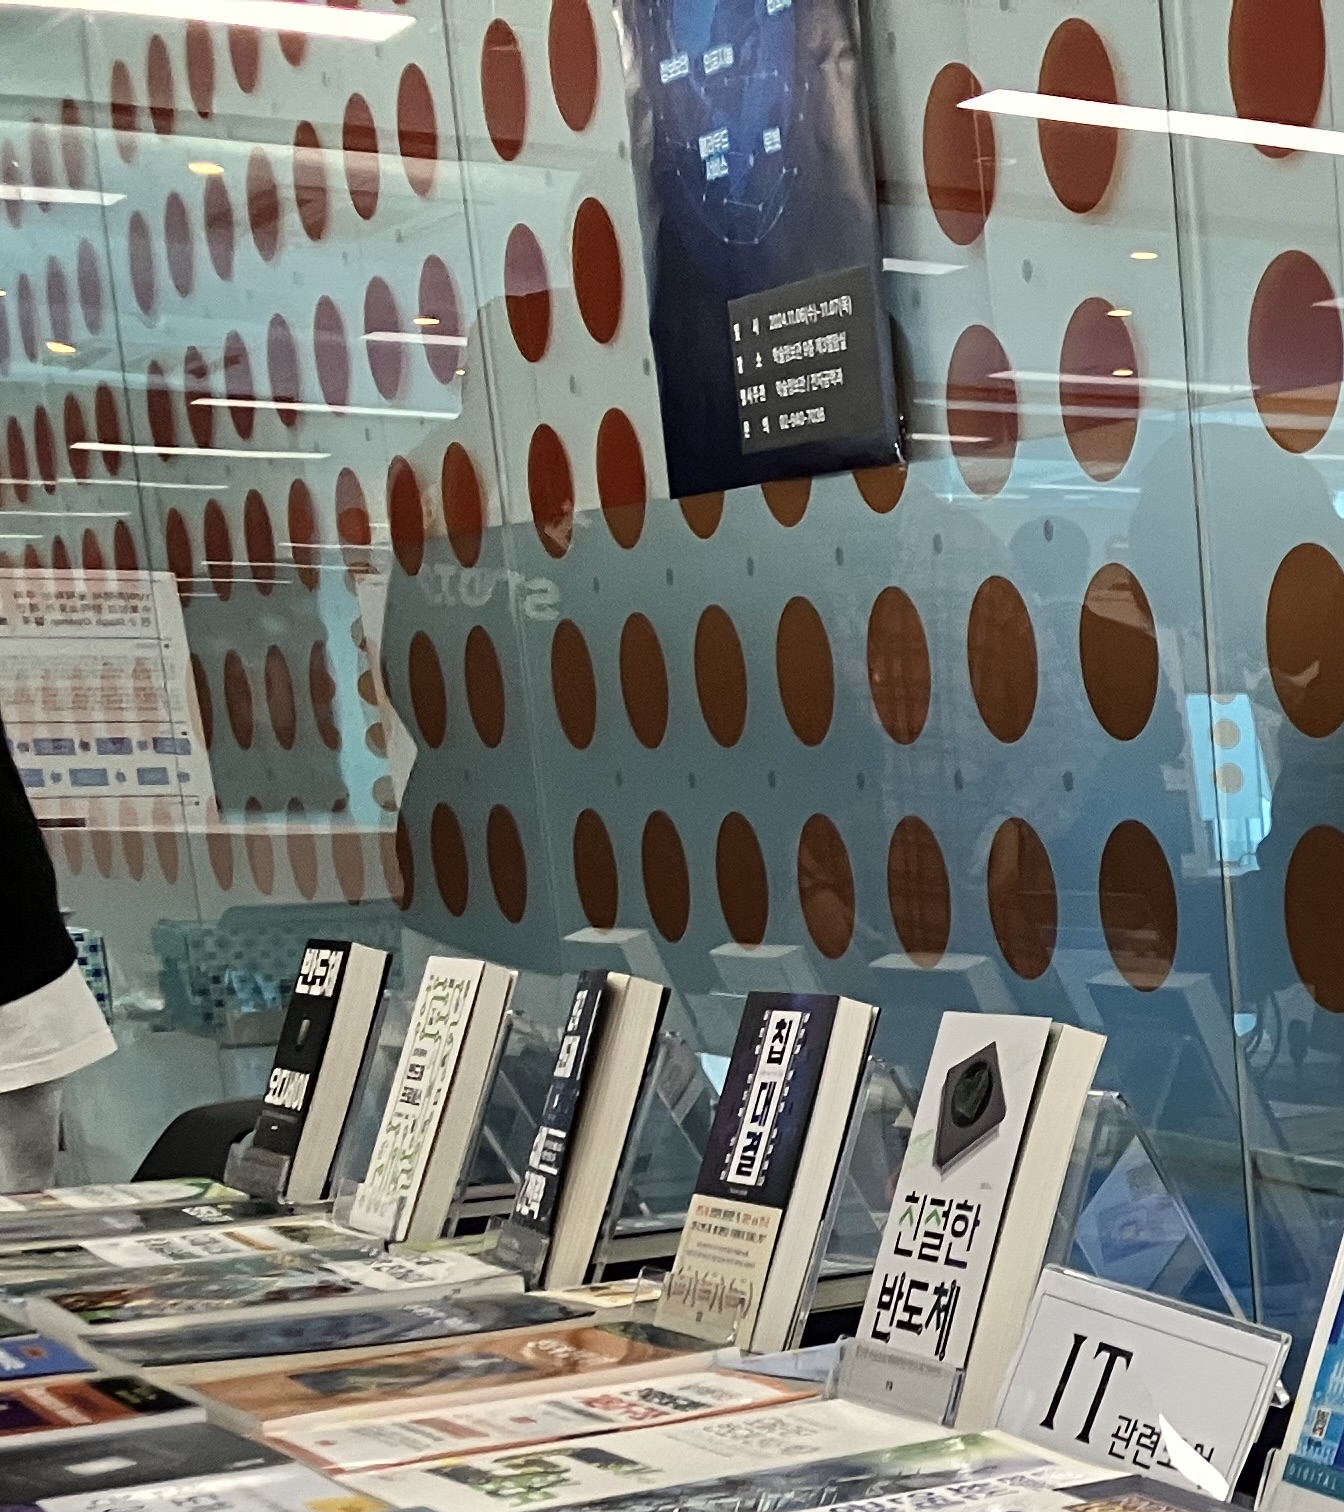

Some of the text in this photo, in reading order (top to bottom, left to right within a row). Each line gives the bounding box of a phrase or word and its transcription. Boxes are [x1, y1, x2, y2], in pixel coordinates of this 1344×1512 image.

[894, 1190, 982, 1271] 친절한
[873, 1270, 962, 1362] 반도체
[1039, 1333, 1134, 1444] IT
[1288, 1462, 1337, 1491] DIGITAL
